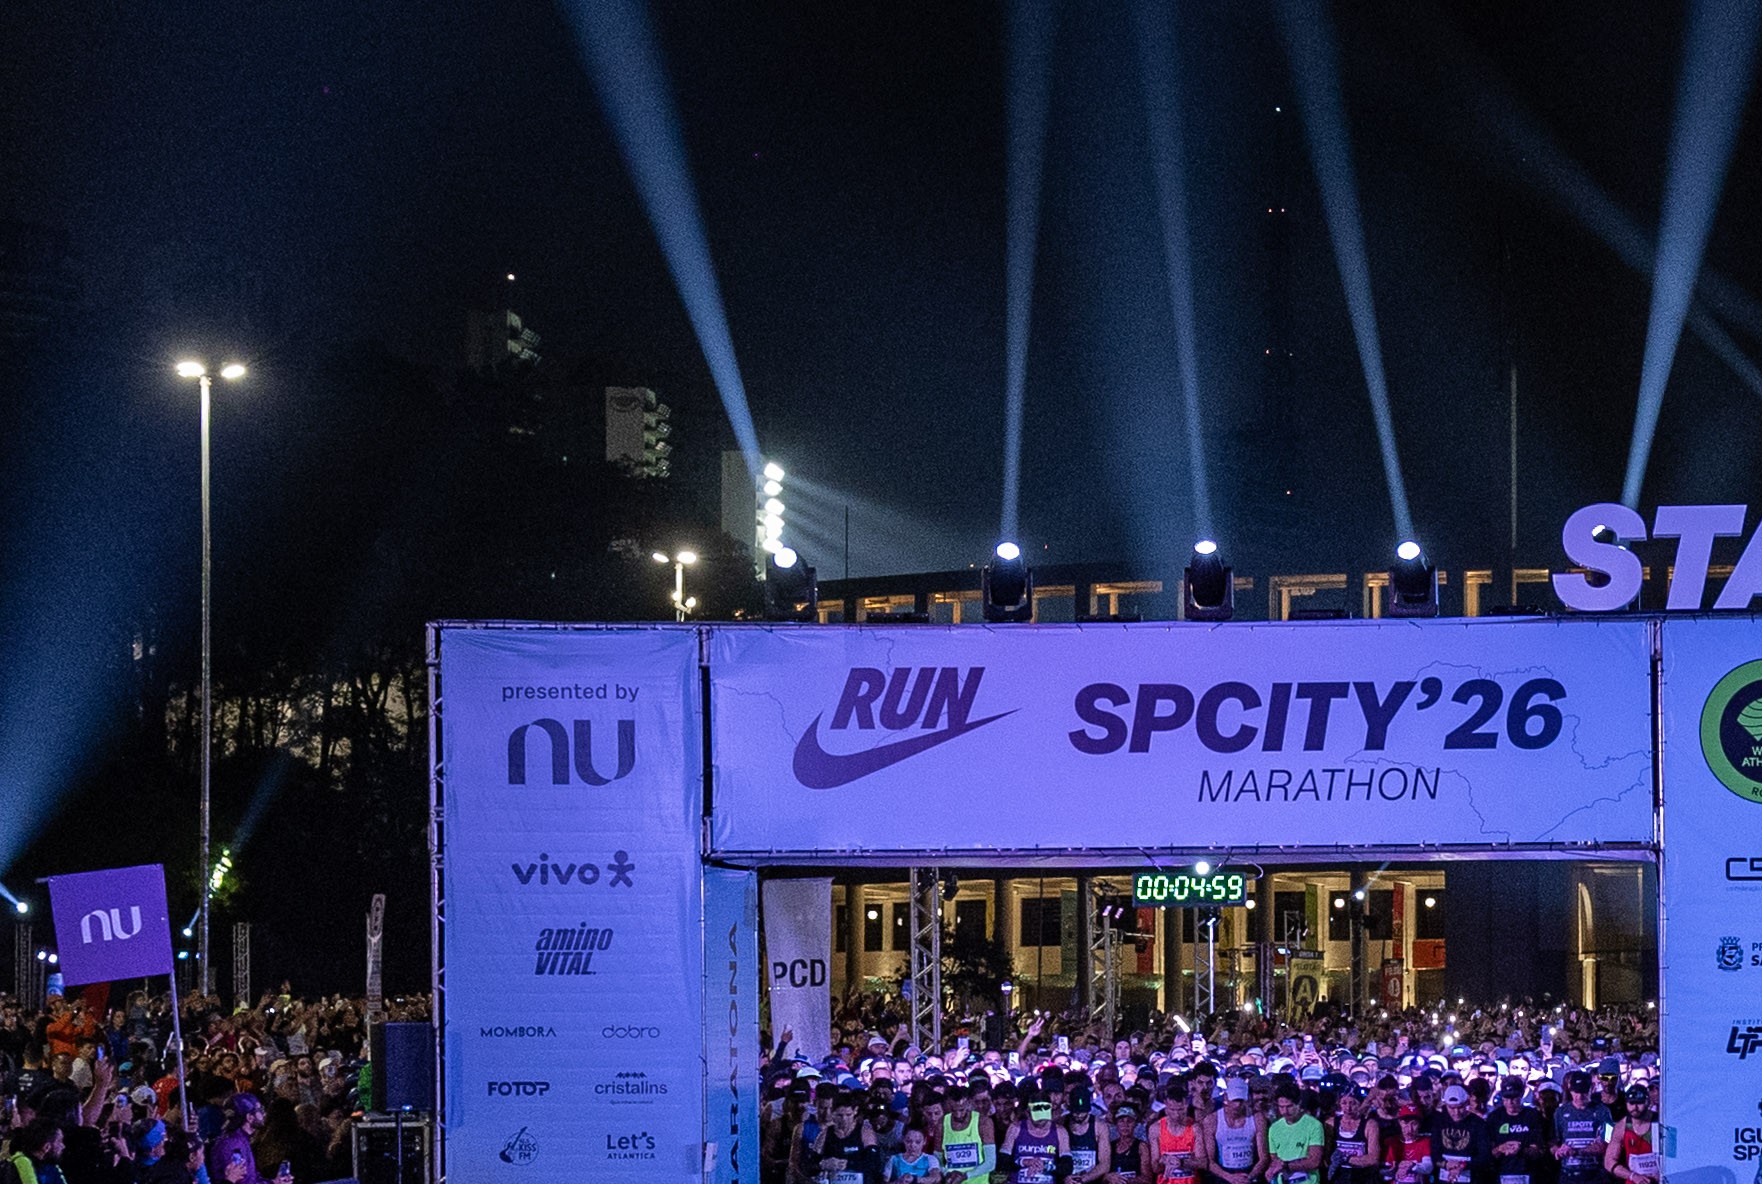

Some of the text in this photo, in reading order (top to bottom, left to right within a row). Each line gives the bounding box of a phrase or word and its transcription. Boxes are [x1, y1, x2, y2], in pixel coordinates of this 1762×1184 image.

[502, 683, 640, 702] presented by
[830, 666, 985, 731] RUN
[1069, 677, 1568, 756] SPCITY'26
[507, 718, 636, 786] nu
[1197, 767, 1441, 803] MARATHON
[512, 852, 600, 885] vivo
[1136, 875, 1243, 899] 00:04:59
[80, 905, 142, 944] nu
[536, 922, 613, 951] amino
[773, 959, 826, 988] PCD
[1296, 978, 1313, 1001] A
[480, 1026, 557, 1038] MOMBORA
[602, 1024, 660, 1039] dobro
[487, 1081, 550, 1096] FOTOP
[594, 1080, 668, 1095] cristalins
[606, 1131, 655, 1150] Let's
[519, 1152, 531, 1160] FM
